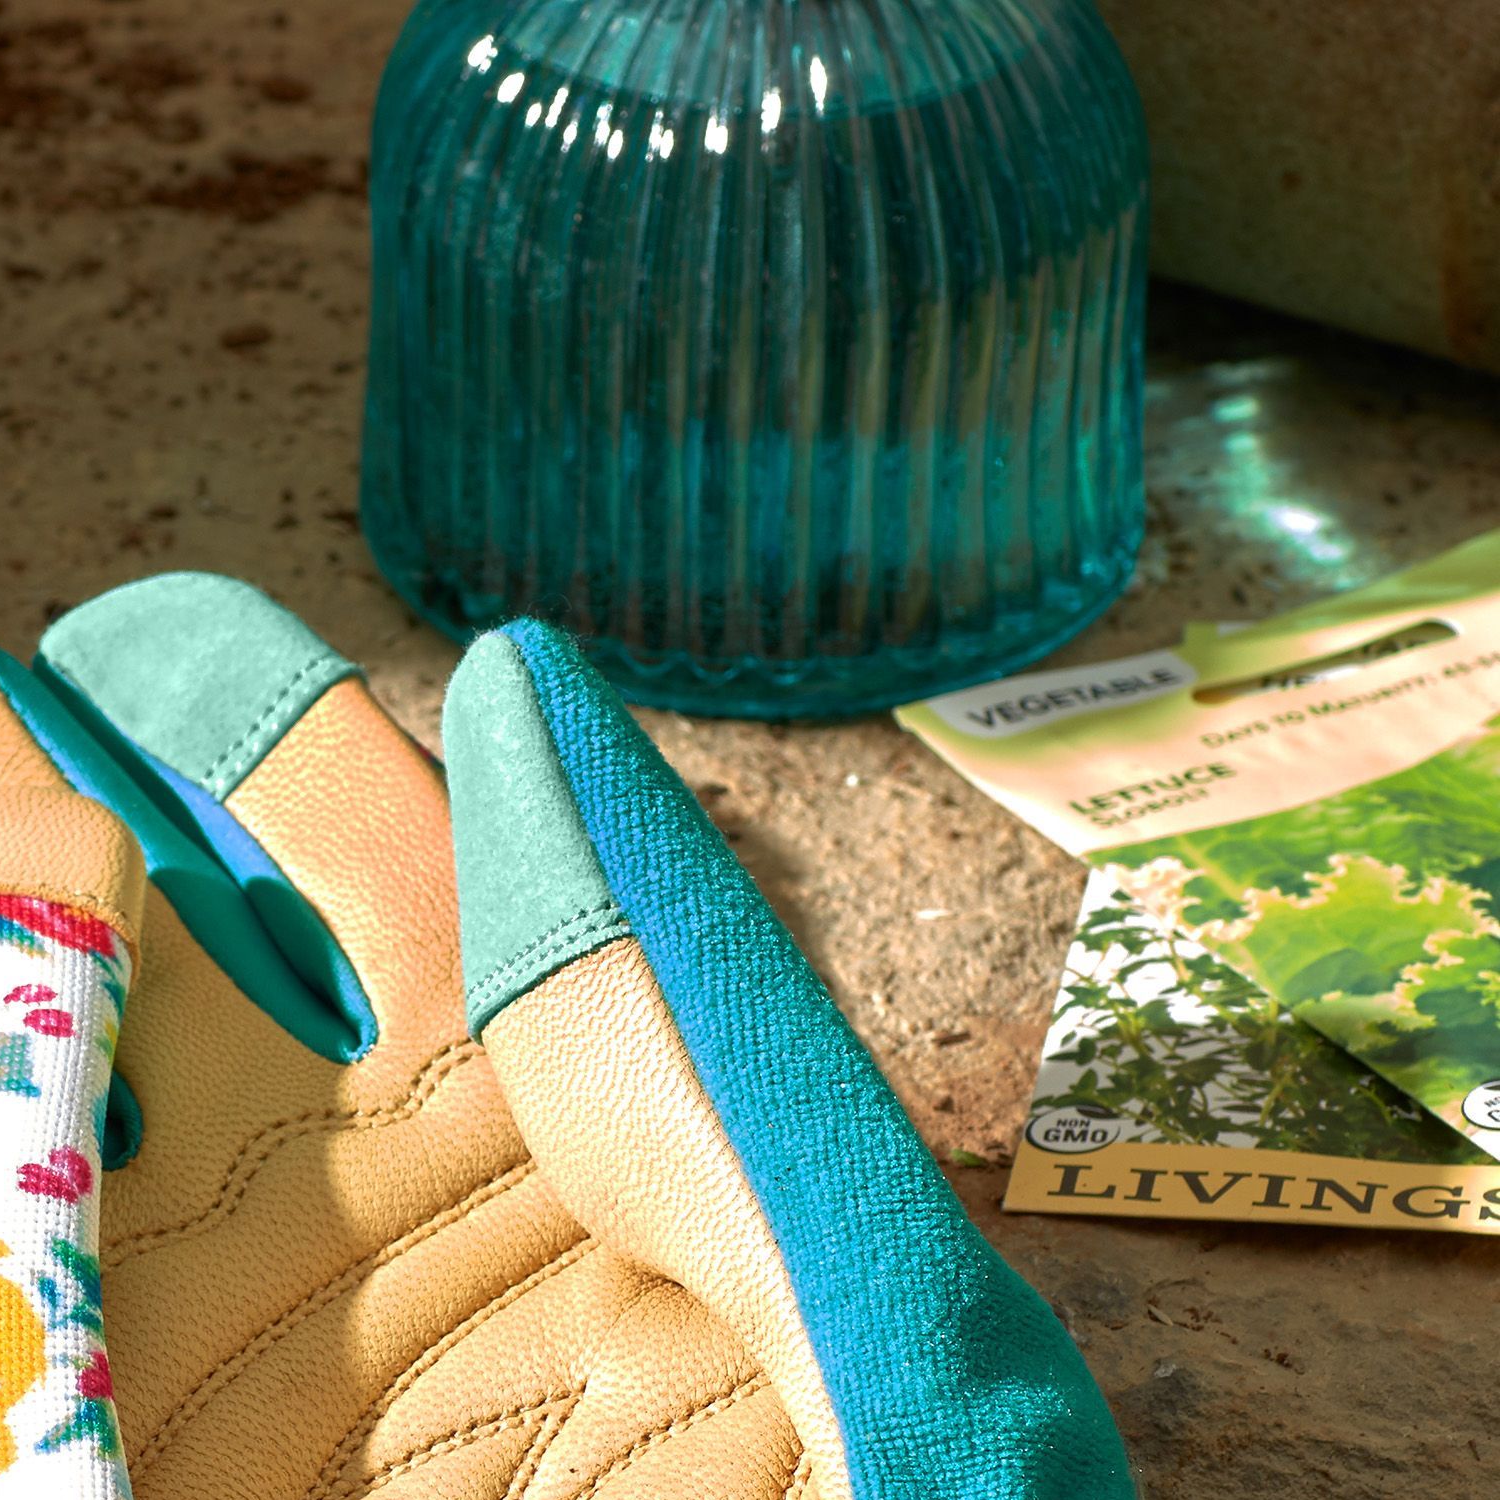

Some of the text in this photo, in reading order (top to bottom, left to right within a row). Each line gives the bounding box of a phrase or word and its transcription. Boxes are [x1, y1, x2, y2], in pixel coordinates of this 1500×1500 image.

[966, 667, 1184, 729] VEGETABLE
[1069, 761, 1238, 815] LETTUCE
[1043, 1128, 1108, 1143] GMO
[1056, 1118, 1091, 1128] NON
